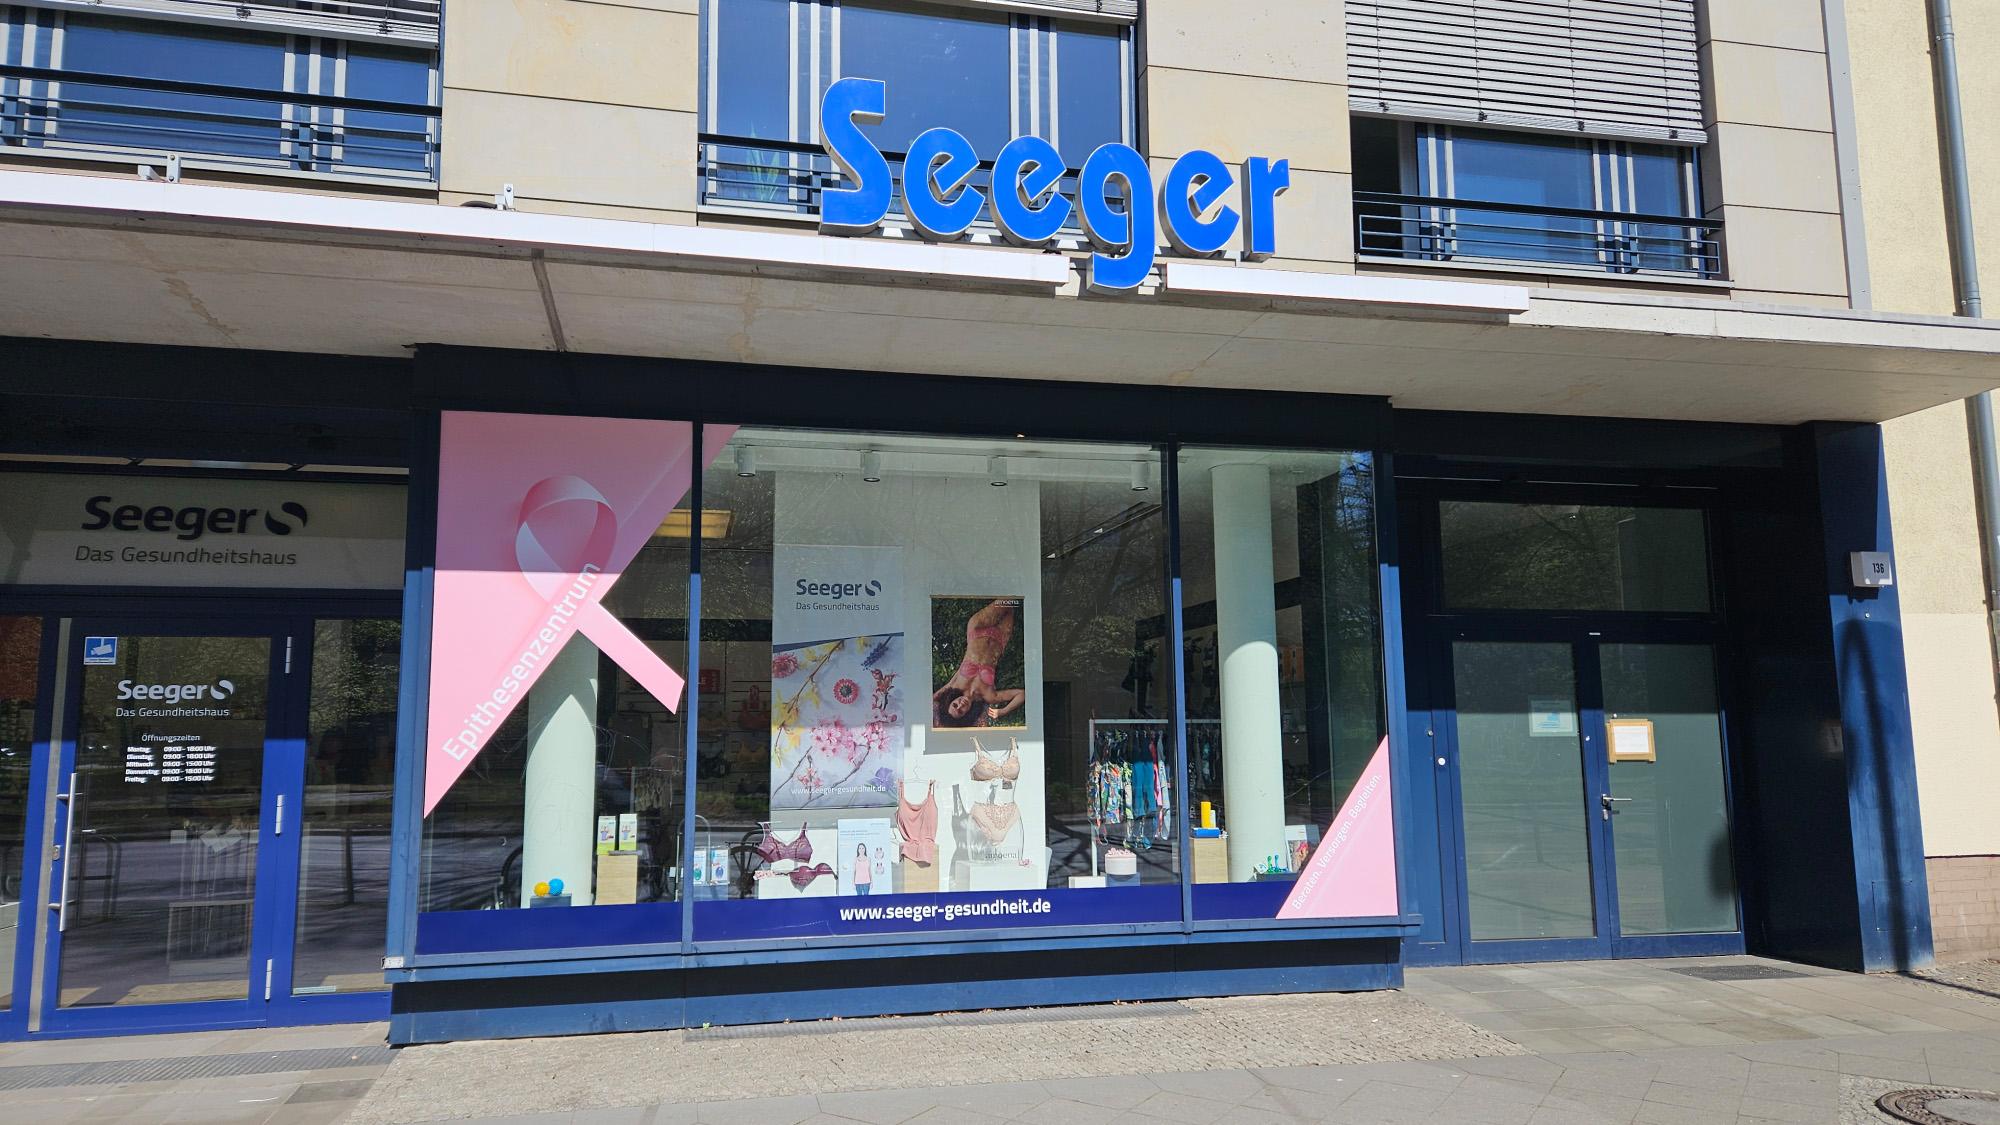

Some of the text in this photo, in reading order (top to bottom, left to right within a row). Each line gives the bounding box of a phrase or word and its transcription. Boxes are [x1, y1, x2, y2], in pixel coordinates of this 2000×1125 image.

[819, 76, 1291, 292] Seeger
[80, 495, 257, 541] Seeger
[75, 545, 297, 566] Das Gesundheitshaus
[1872, 562, 1885, 574] 136
[796, 578, 862, 600] Seeger
[796, 602, 880, 612] Das Gesundheitshaus
[441, 561, 601, 762] Epithesenzentrum
[116, 679, 207, 704] Seeger
[115, 706, 230, 718] Das Gesundheitshaus
[141, 732, 201, 743] Öffnungszeiten
[124, 776, 148, 784] Freitag
[791, 784, 886, 796] www.seeger-gesundheit.de
[1292, 773, 1382, 911] Beraten. Versorgen. Begleiten.
[840, 899, 1051, 921] www.seeger-gesundheit.de
